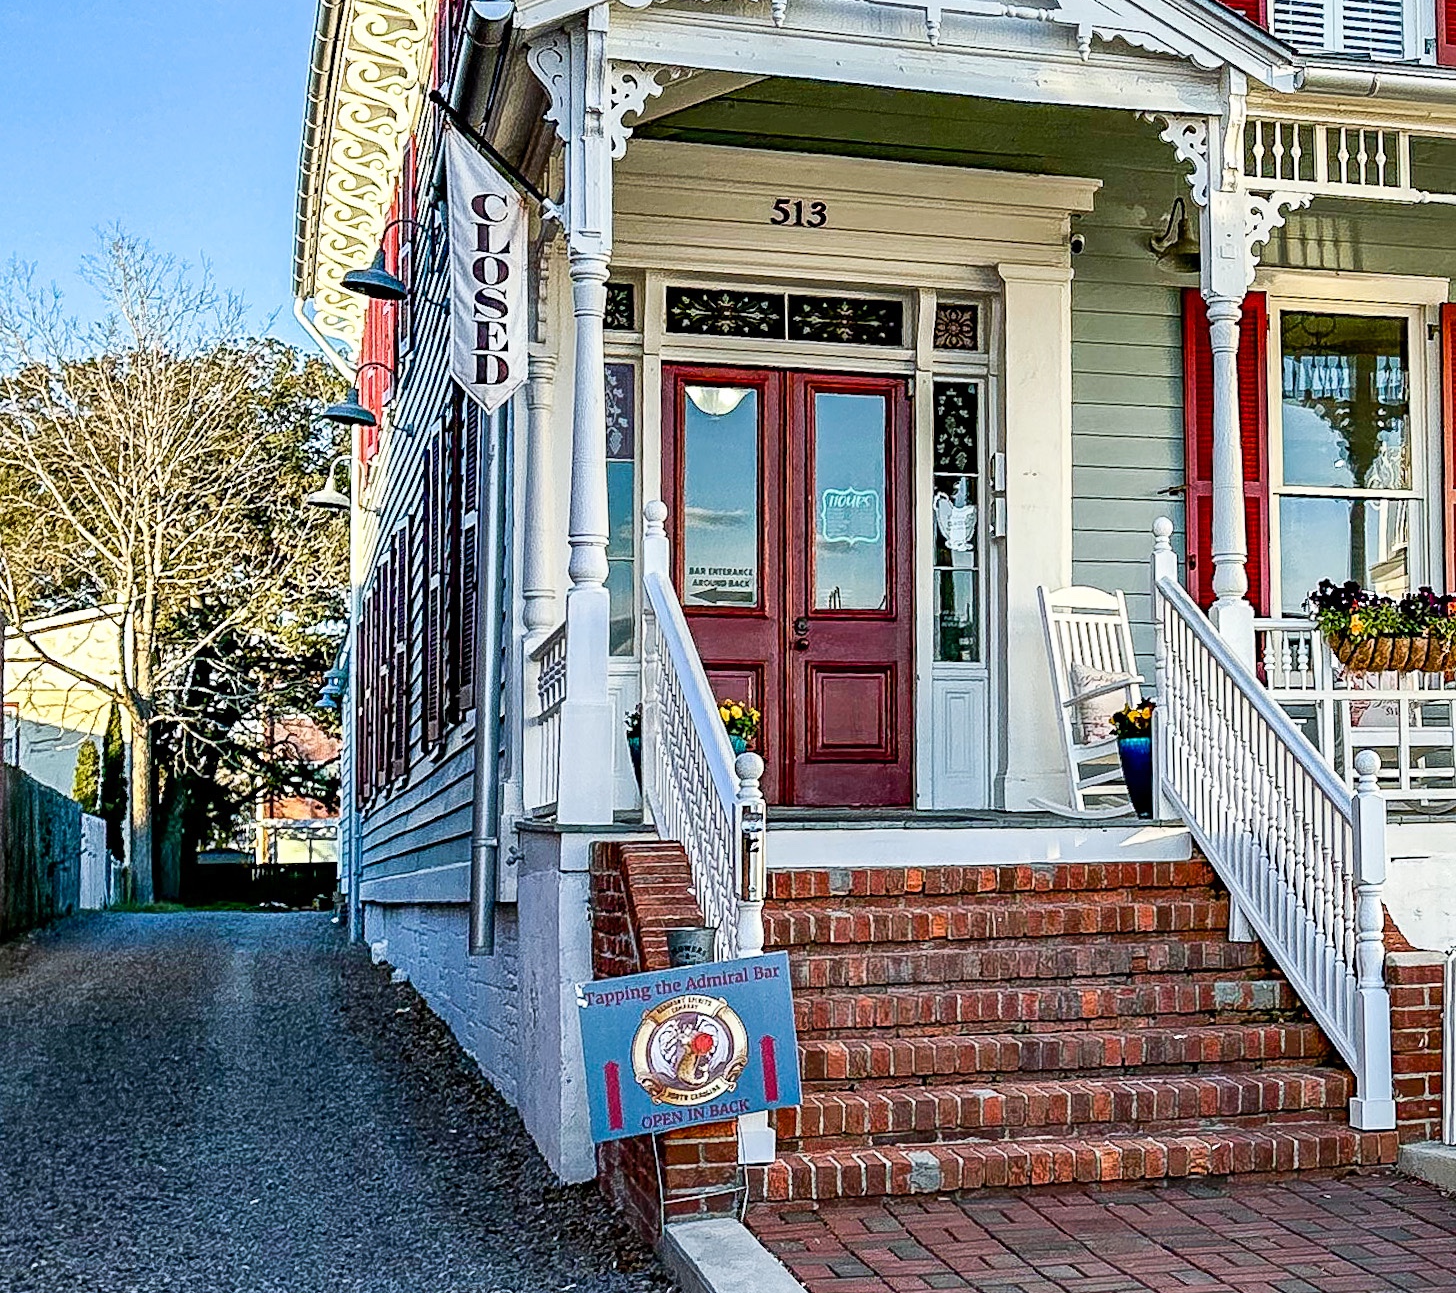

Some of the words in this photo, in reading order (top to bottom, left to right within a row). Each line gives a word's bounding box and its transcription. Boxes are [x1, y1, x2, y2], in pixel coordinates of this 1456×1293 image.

[770, 198, 827, 228] 513
[471, 193, 510, 385] CLOSED
[689, 567, 706, 575] BAR
[585, 986, 651, 1007] Tapping
[655, 980, 681, 995] the
[686, 967, 748, 990] Admiral
[753, 966, 779, 980] Bar
[642, 1111, 682, 1128] OPEN
[687, 1107, 704, 1121] IN
[709, 1099, 750, 1117] BACK
